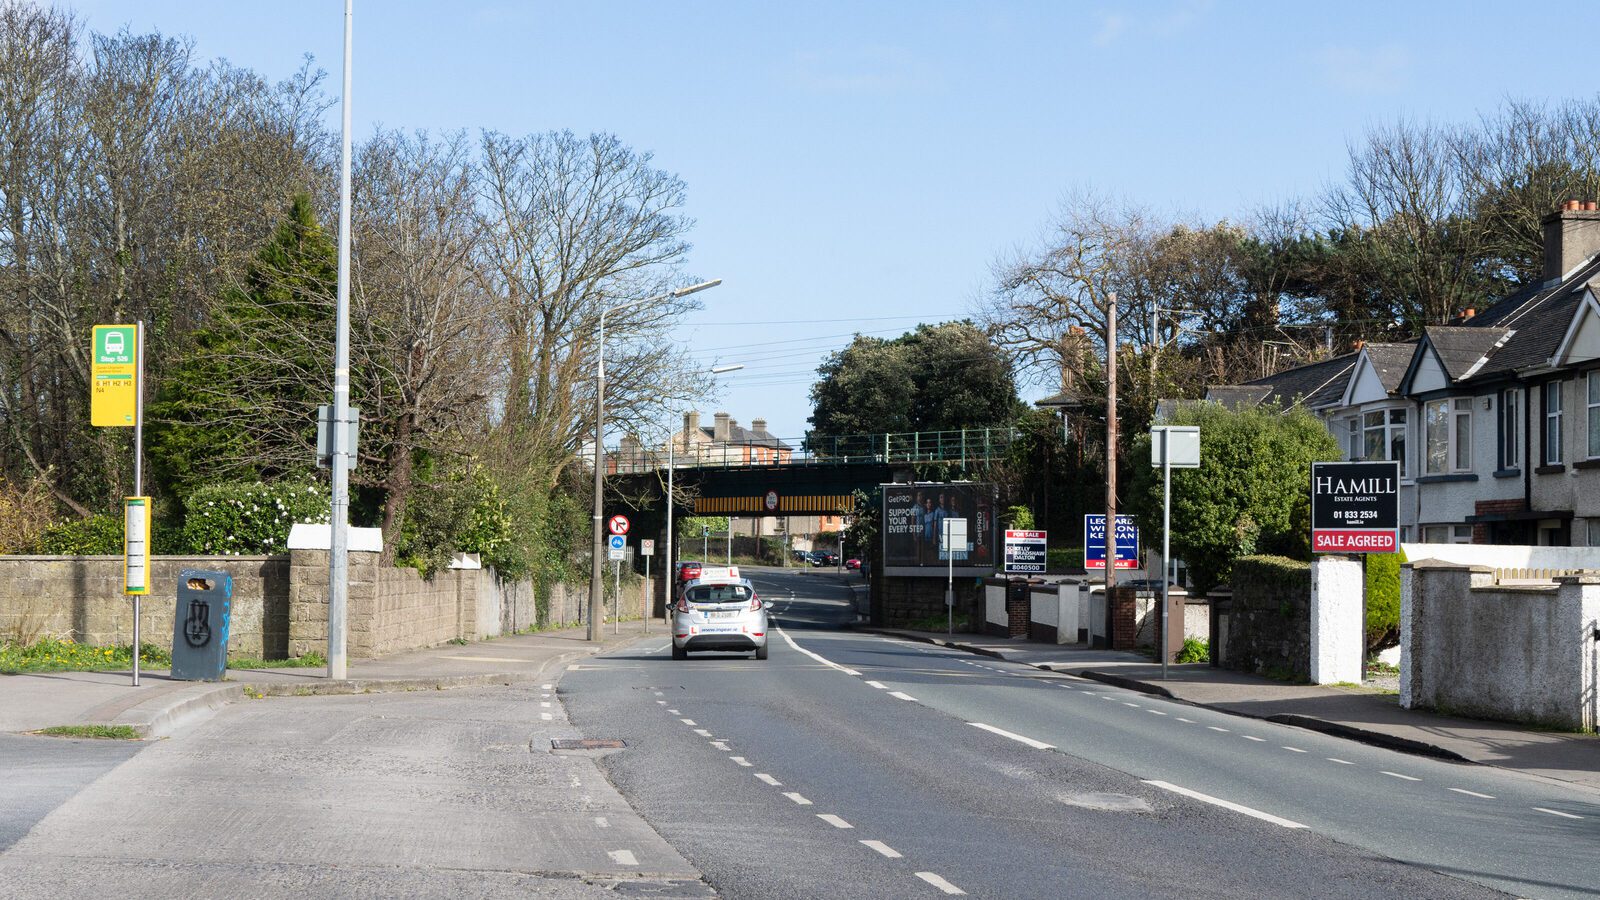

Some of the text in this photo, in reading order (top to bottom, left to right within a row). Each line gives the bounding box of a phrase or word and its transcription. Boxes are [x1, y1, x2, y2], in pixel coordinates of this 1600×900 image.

[1316, 476, 1395, 494] HAMILL
[888, 509, 919, 517] SUPPORT
[888, 517, 907, 525] YOUR
[888, 525, 924, 533] EVERY STEP
[1317, 535, 1393, 547] SALE AGREED
[729, 569, 737, 577] L
